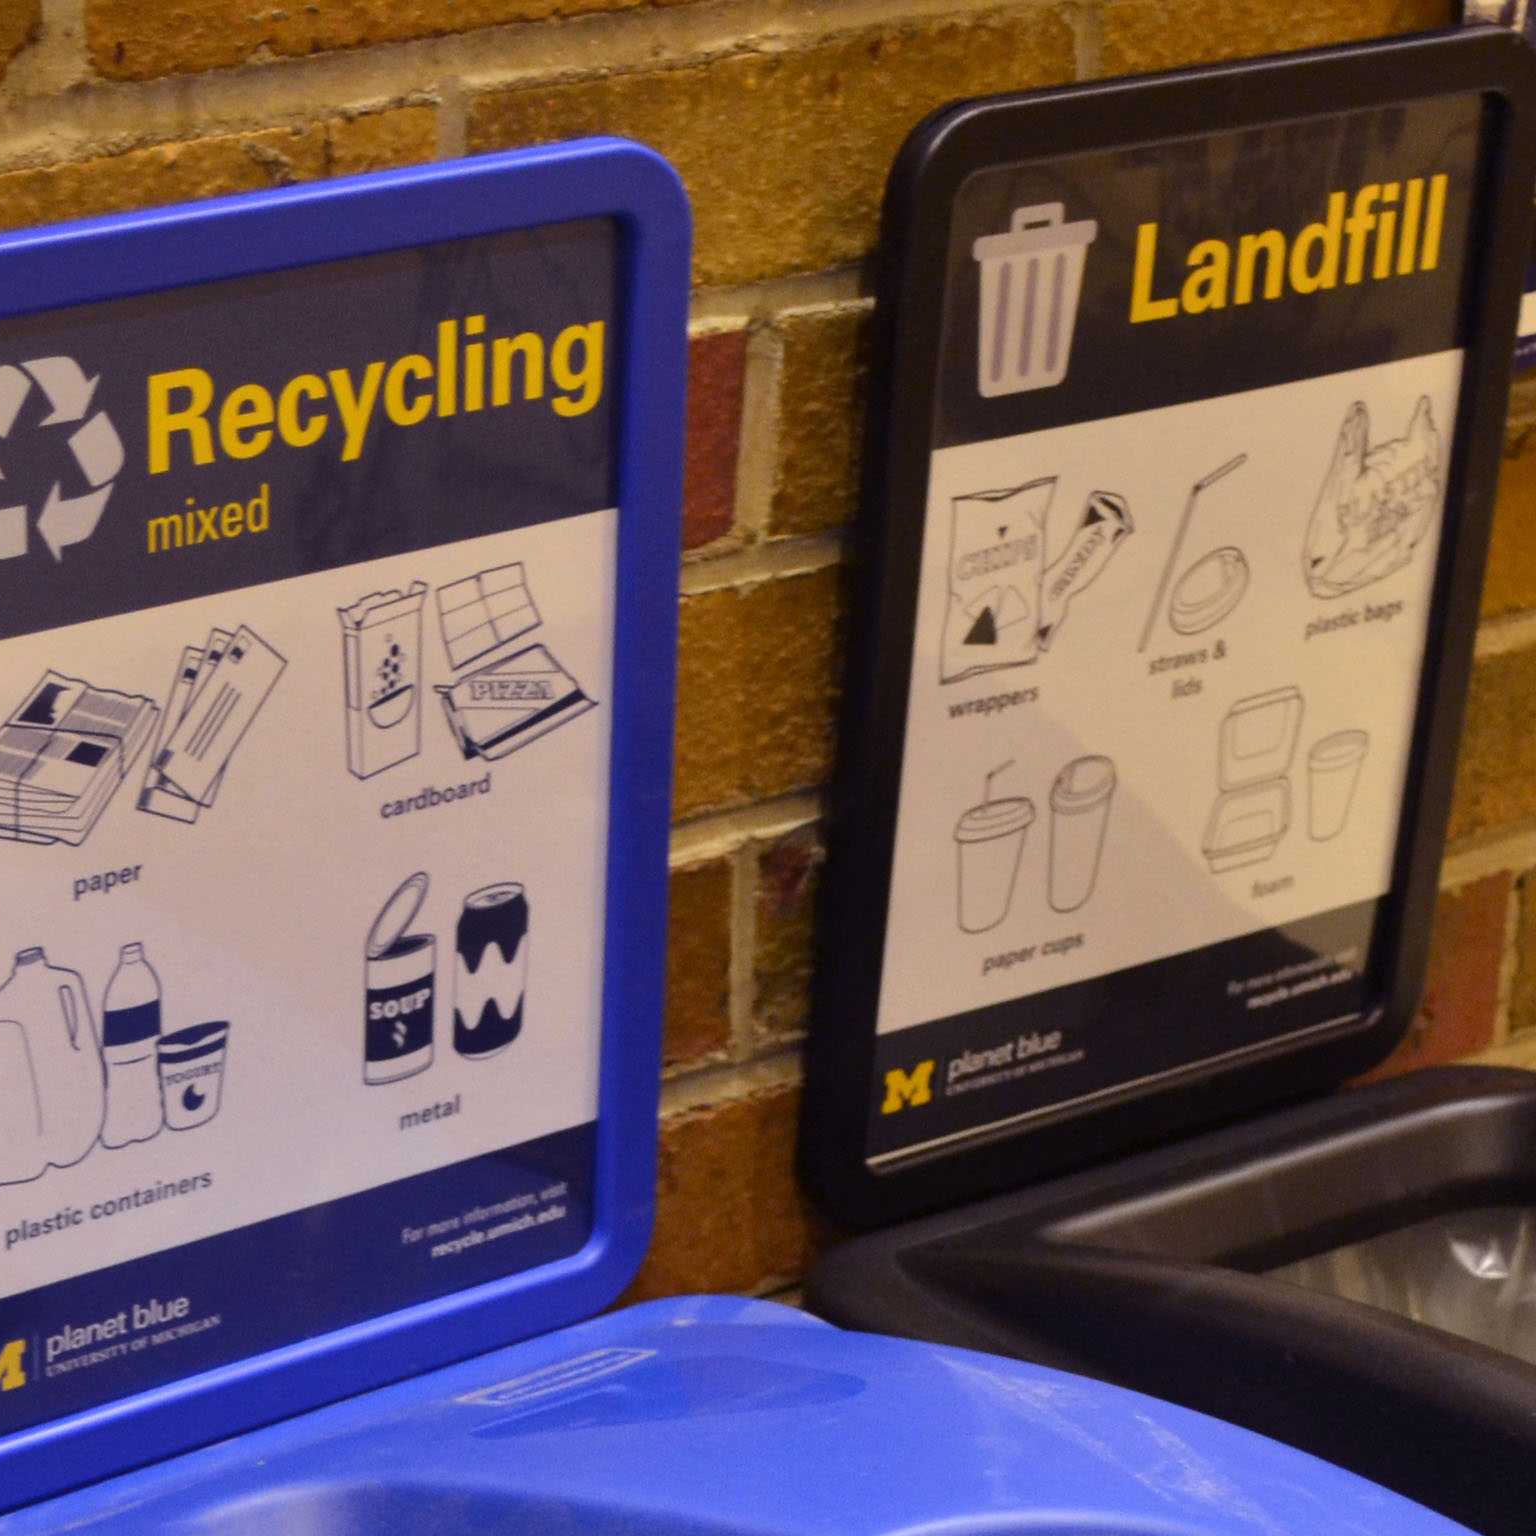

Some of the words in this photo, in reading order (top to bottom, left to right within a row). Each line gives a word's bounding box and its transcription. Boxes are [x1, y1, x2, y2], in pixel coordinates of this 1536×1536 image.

[1129, 174, 1448, 324] Landfill
[147, 314, 605, 475] Recycling
[147, 484, 269, 554] mixed
[1305, 612, 1359, 642] plastic
[1364, 601, 1403, 623] bags
[1149, 648, 1208, 676] straws
[1213, 639, 1227, 661] &
[948, 686, 1039, 719] wrappers
[1171, 677, 1204, 699] lids
[380, 772, 491, 821] cardboard
[73, 861, 143, 901] paper
[982, 939, 1036, 976] paper
[1041, 929, 1085, 962] cups
[369, 986, 432, 1022] SOUP
[881, 1058, 937, 1115] M
[946, 1042, 1015, 1084] planet
[1017, 1031, 1063, 1060] blue
[399, 1095, 462, 1131] metal
[5, 1205, 84, 1251] plastic
[90, 1169, 213, 1223] containers
[44, 1312, 128, 1362] planet
[132, 1296, 190, 1330] blue
